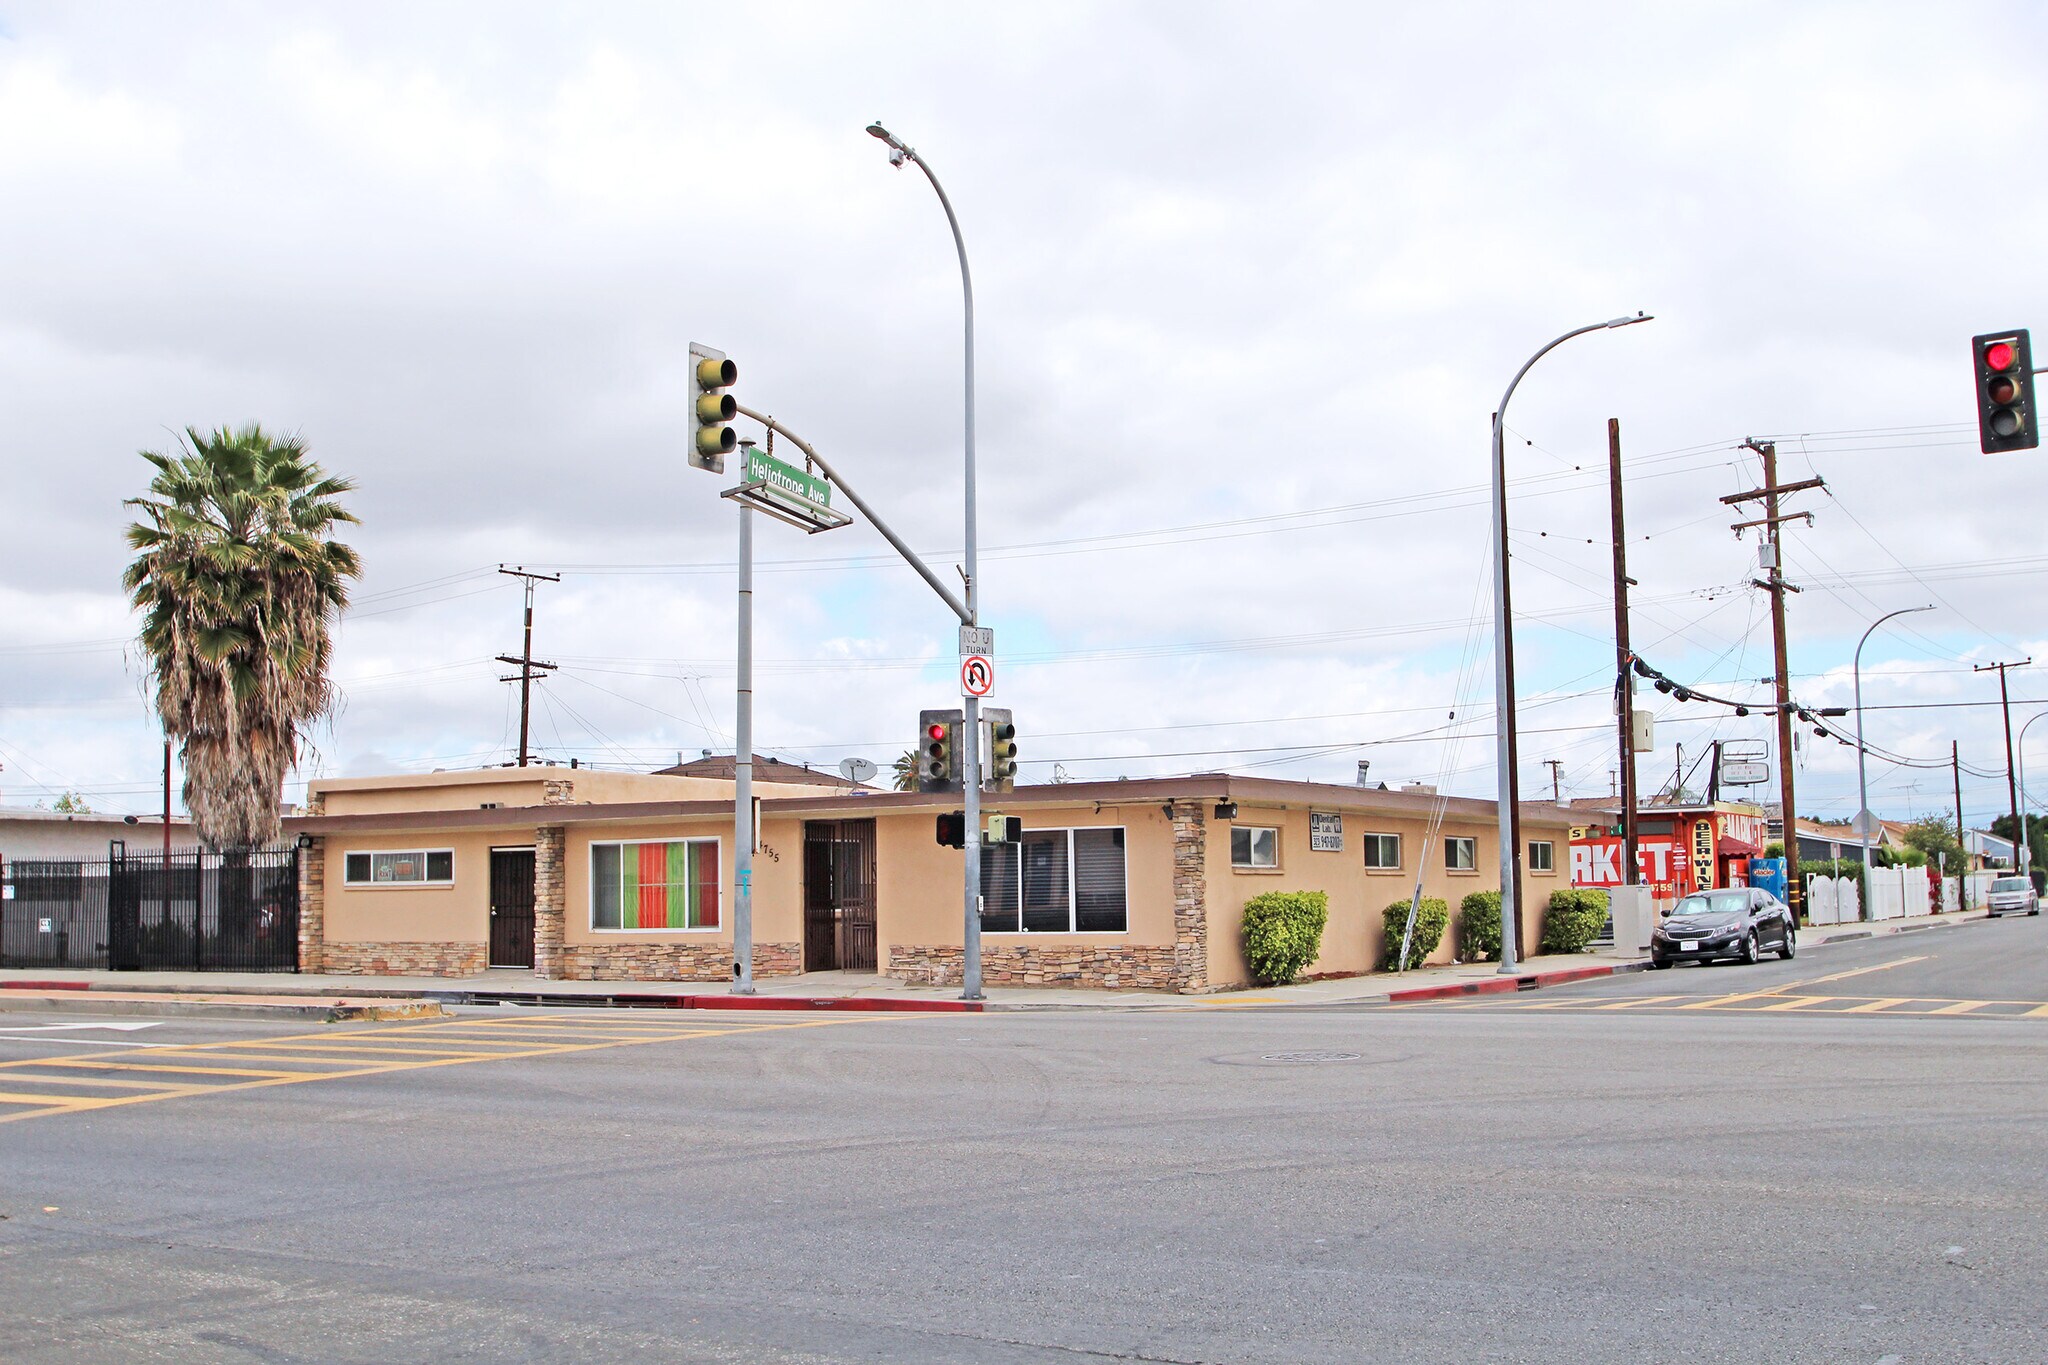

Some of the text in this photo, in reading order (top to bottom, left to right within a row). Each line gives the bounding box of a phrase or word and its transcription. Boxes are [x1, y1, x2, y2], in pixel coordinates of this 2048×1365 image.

[751, 457, 825, 505] Heliotrope Ave
[964, 631, 990, 644] NO U
[966, 646, 987, 654] TURN
[1319, 814, 1334, 823] Dental
[1694, 823, 1712, 890] BEER WINE
